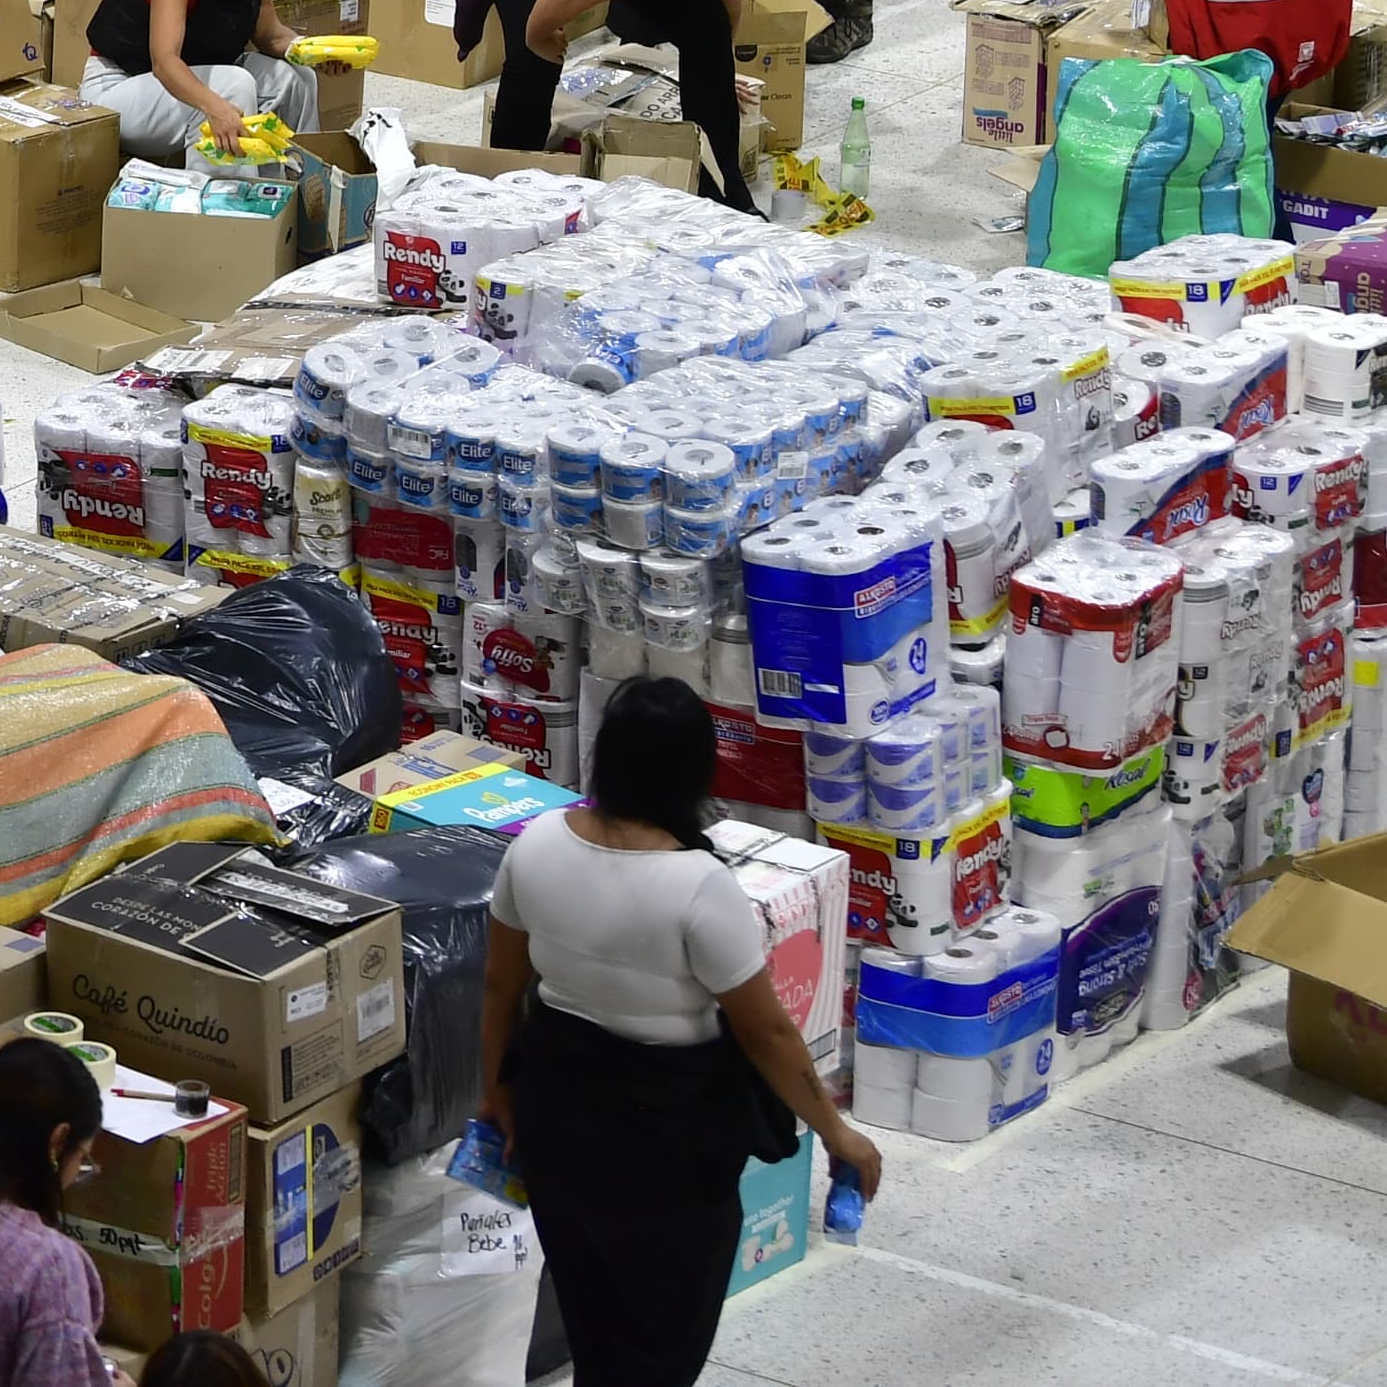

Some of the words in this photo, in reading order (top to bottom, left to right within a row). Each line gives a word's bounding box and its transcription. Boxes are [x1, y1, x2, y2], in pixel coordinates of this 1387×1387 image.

[975, 116, 1024, 135] angels
[988, 129, 1015, 144] little
[452, 242, 465, 252] 12
[383, 241, 446, 274] Rendy
[1187, 283, 1205, 297] 18
[302, 380, 325, 401] Elite
[1015, 394, 1033, 409] 18
[461, 443, 492, 459] Elite
[353, 463, 382, 481] Elite
[503, 456, 532, 472] Elite
[201, 461, 271, 489] Rendy
[403, 475, 431, 493] Elite
[1314, 458, 1365, 493] Rendy
[452, 488, 479, 505] Elite
[61, 490, 145, 528] Rendy
[901, 842, 917, 853] 18
[955, 838, 1004, 882] Rendy
[91, 900, 156, 930] CORAZÓN
[157, 923, 180, 939] DE
[71, 974, 130, 1014] Café
[136, 994, 232, 1046] Quindío
